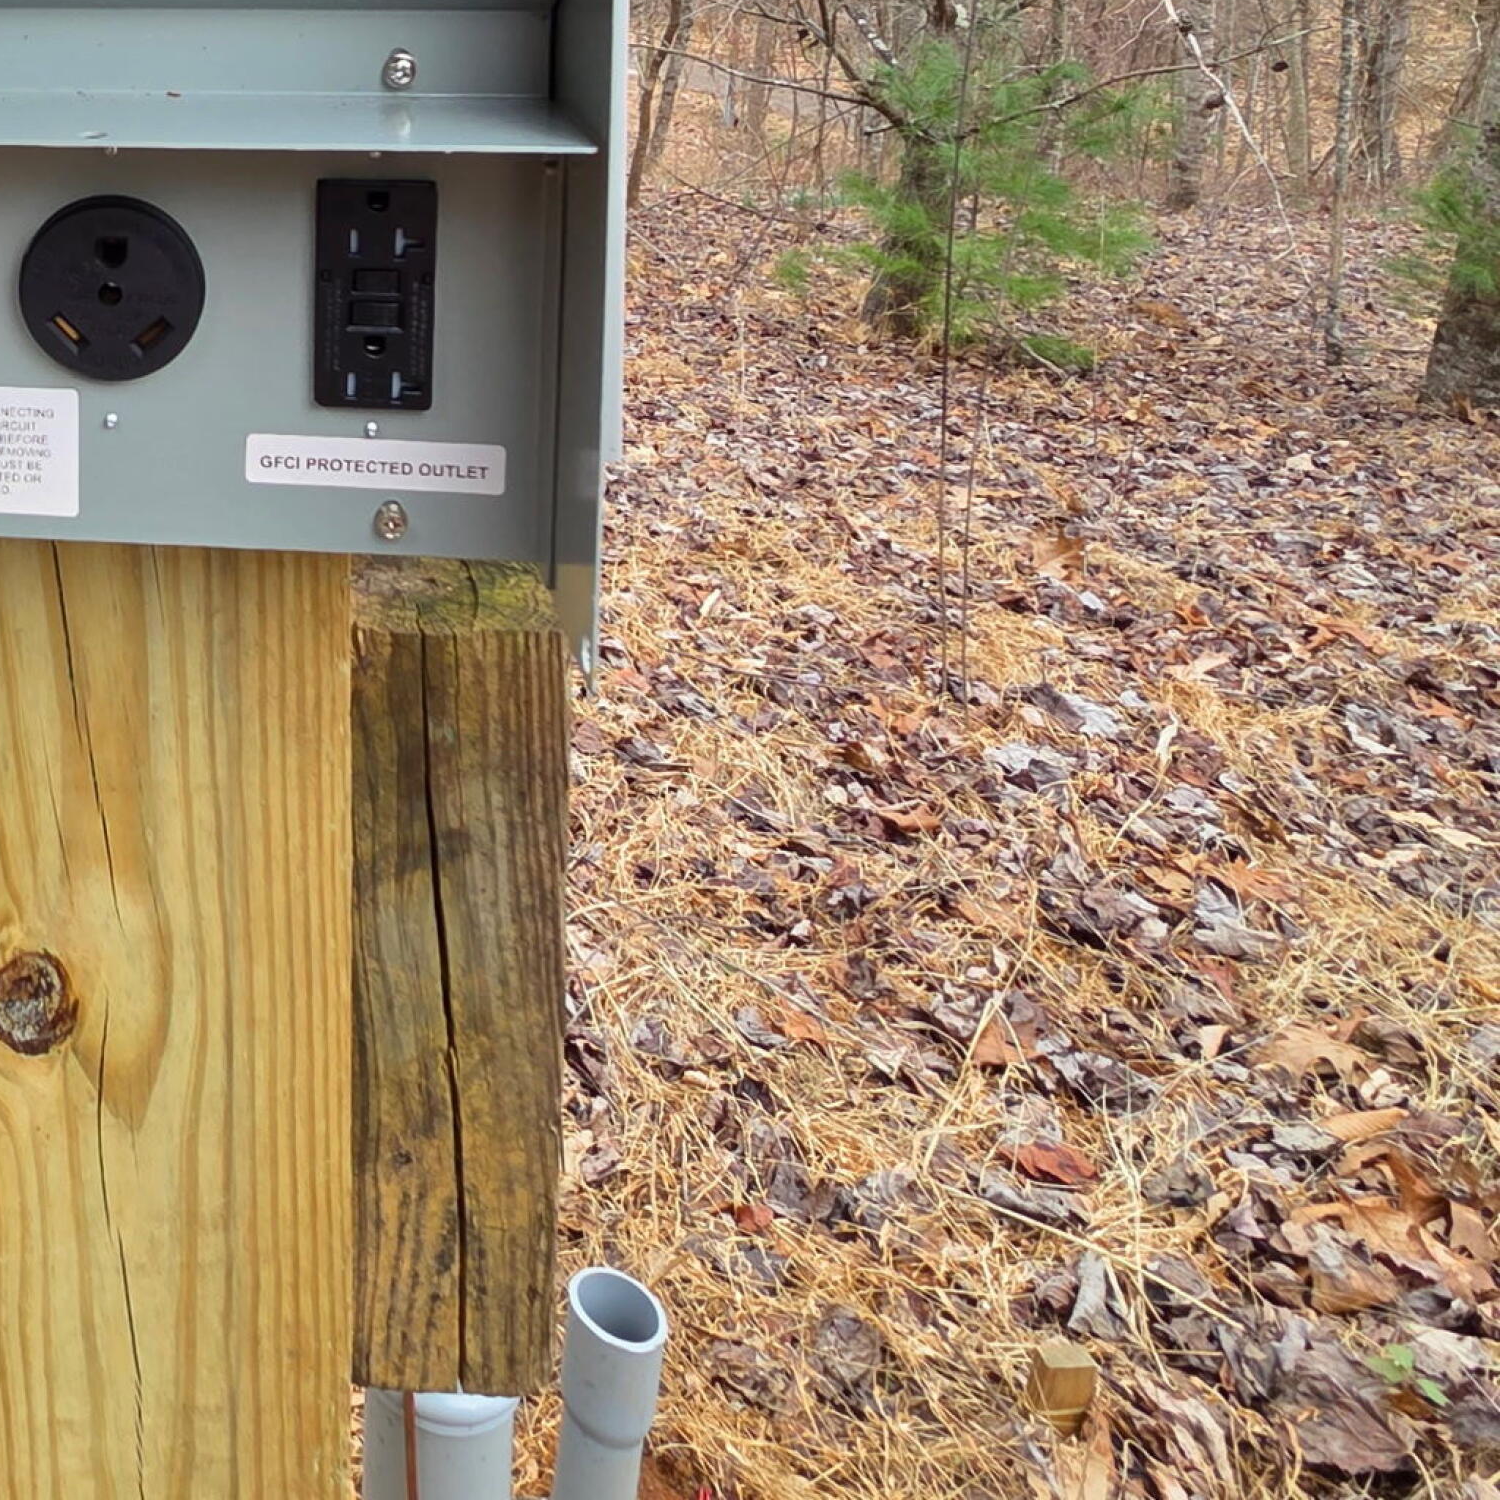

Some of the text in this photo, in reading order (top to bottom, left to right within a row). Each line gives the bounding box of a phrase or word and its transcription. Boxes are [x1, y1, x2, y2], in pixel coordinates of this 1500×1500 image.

[0, 433, 48, 445] BEFORE
[27, 460, 43, 470] BE
[260, 455, 489, 480] GFCI PROTECTED OUTLET
[24, 473, 41, 483] OR
